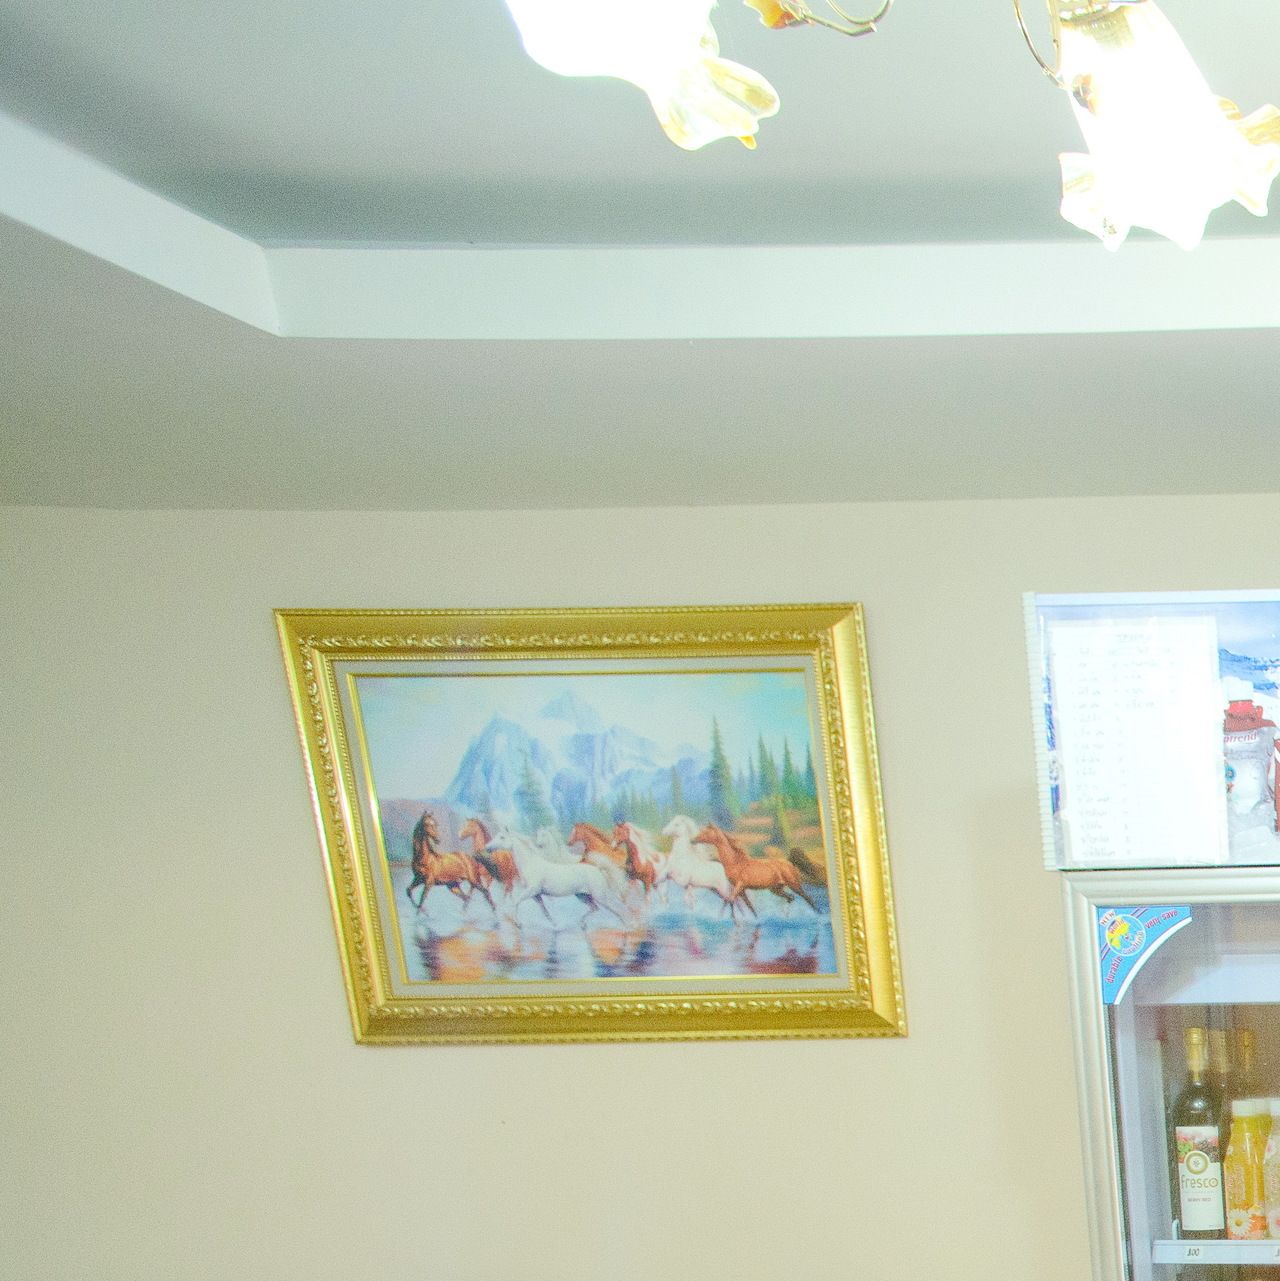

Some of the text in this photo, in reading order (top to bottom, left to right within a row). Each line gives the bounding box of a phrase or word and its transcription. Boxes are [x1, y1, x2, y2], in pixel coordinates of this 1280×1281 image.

[1145, 909, 1179, 929] very save
[1104, 956, 1124, 984] durable
[1180, 1175, 1219, 1189] fresco
